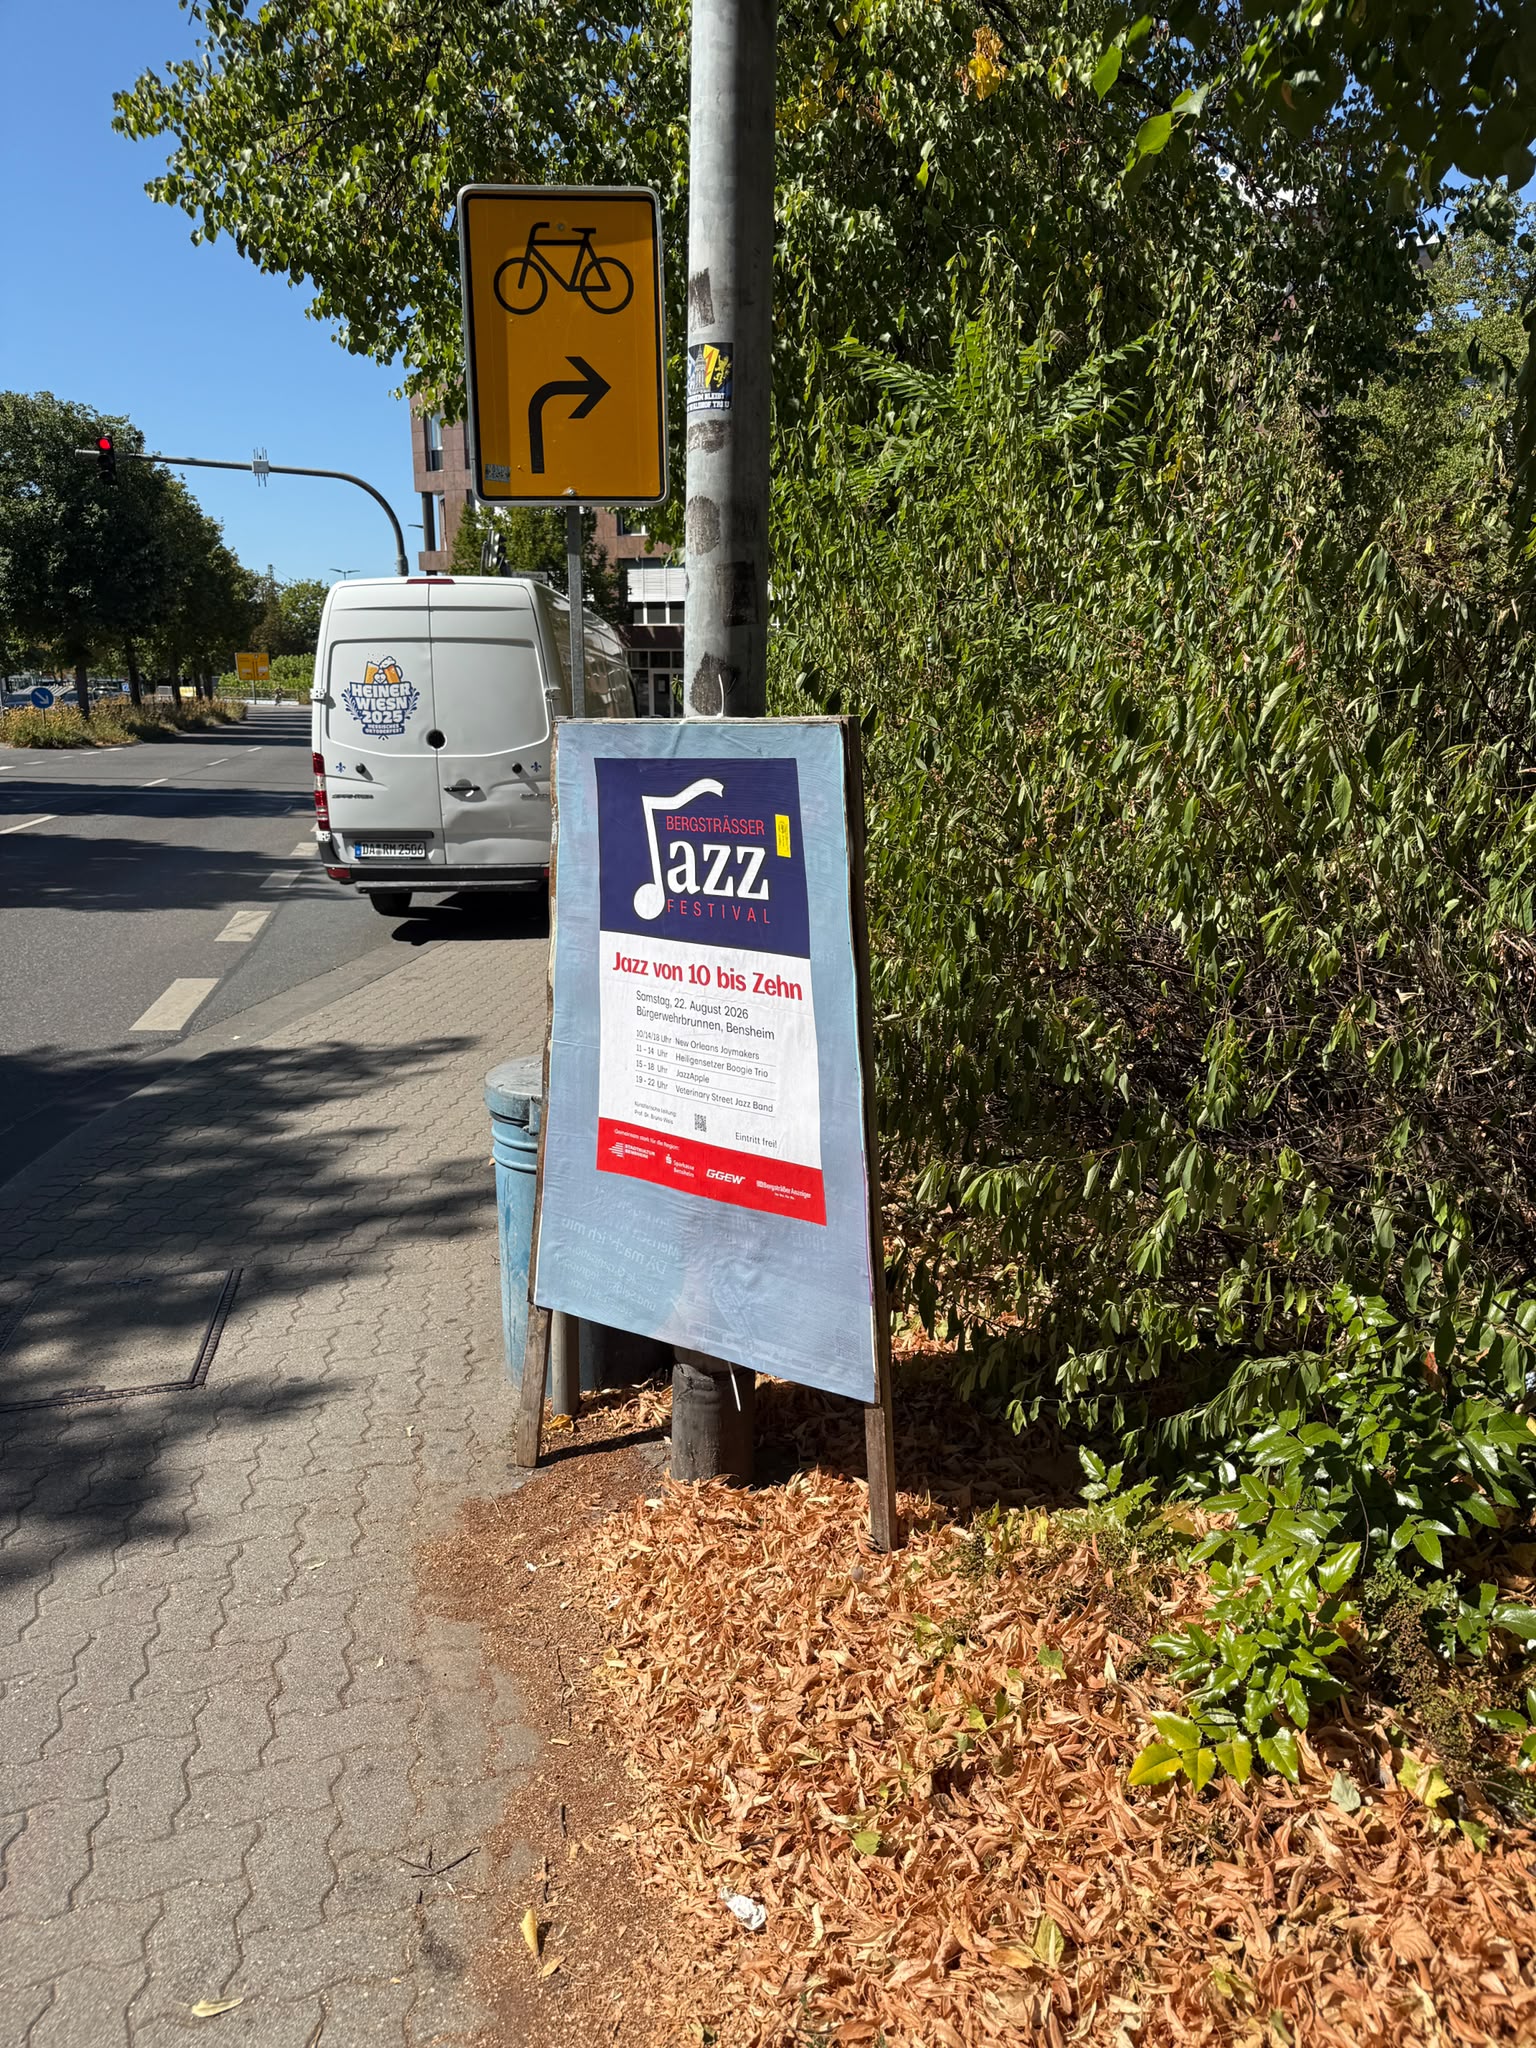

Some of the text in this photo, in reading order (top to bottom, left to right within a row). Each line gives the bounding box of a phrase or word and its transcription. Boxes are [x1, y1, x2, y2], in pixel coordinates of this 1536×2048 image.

[351, 682, 411, 698] HEINER
[355, 697, 408, 711] WIESN
[362, 710, 403, 724] 2025
[666, 815, 765, 835] BERGSTRÄSSER
[362, 843, 424, 855] DA RM 2506
[667, 899, 770, 924] FESTIVAL
[613, 952, 803, 1001] Jazz von 10 bis Zehn
[636, 990, 749, 1020] Samstag, 22. August 2026
[636, 1006, 775, 1040] Bürgerwehrbrunnen, Bensheim
[660, 1034, 672, 1045] Uhr
[675, 1038, 689, 1048] New
[690, 1040, 719, 1053] Orleans
[720, 1045, 760, 1060] Joymakers
[657, 1047, 668, 1058] Uhr
[675, 1053, 725, 1072] Heiligensetzer
[726, 1062, 753, 1076] Boogie
[754, 1067, 769, 1078] Trio
[657, 1063, 668, 1074] Uhr
[675, 1069, 710, 1085] JazzApple
[657, 1079, 668, 1090] Uhr
[675, 1084, 710, 1101] Veterinary
[711, 1092, 734, 1106] Street
[735, 1097, 751, 1109] Jazz
[752, 1100, 774, 1113] Band
[735, 1131, 778, 1149] Eintritt frei!
[706, 1169, 746, 1185] GGEW
